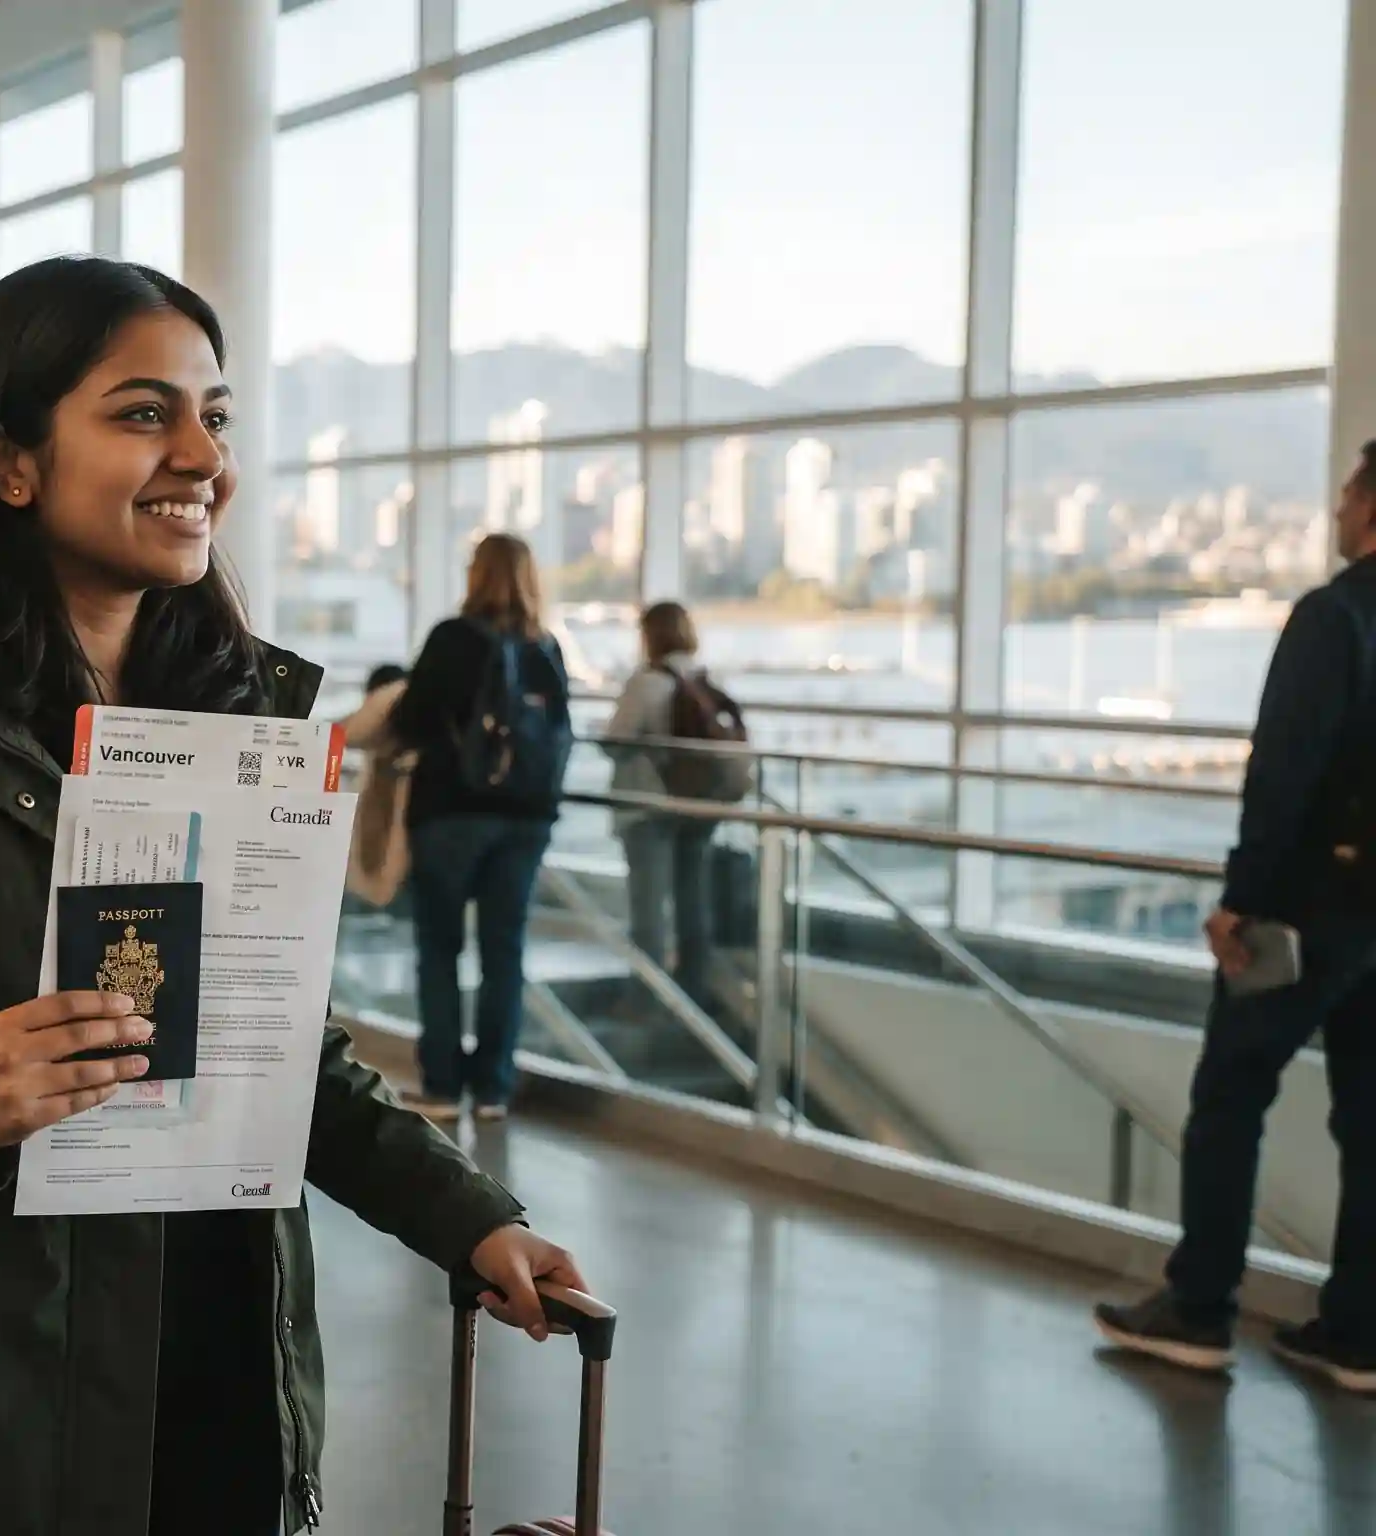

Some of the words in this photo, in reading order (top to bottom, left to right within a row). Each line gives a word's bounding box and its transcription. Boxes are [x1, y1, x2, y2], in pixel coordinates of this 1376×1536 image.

[99, 744, 195, 765] Vancouver
[270, 805, 331, 826] Canada
[98, 908, 165, 922] PASSPOTT
